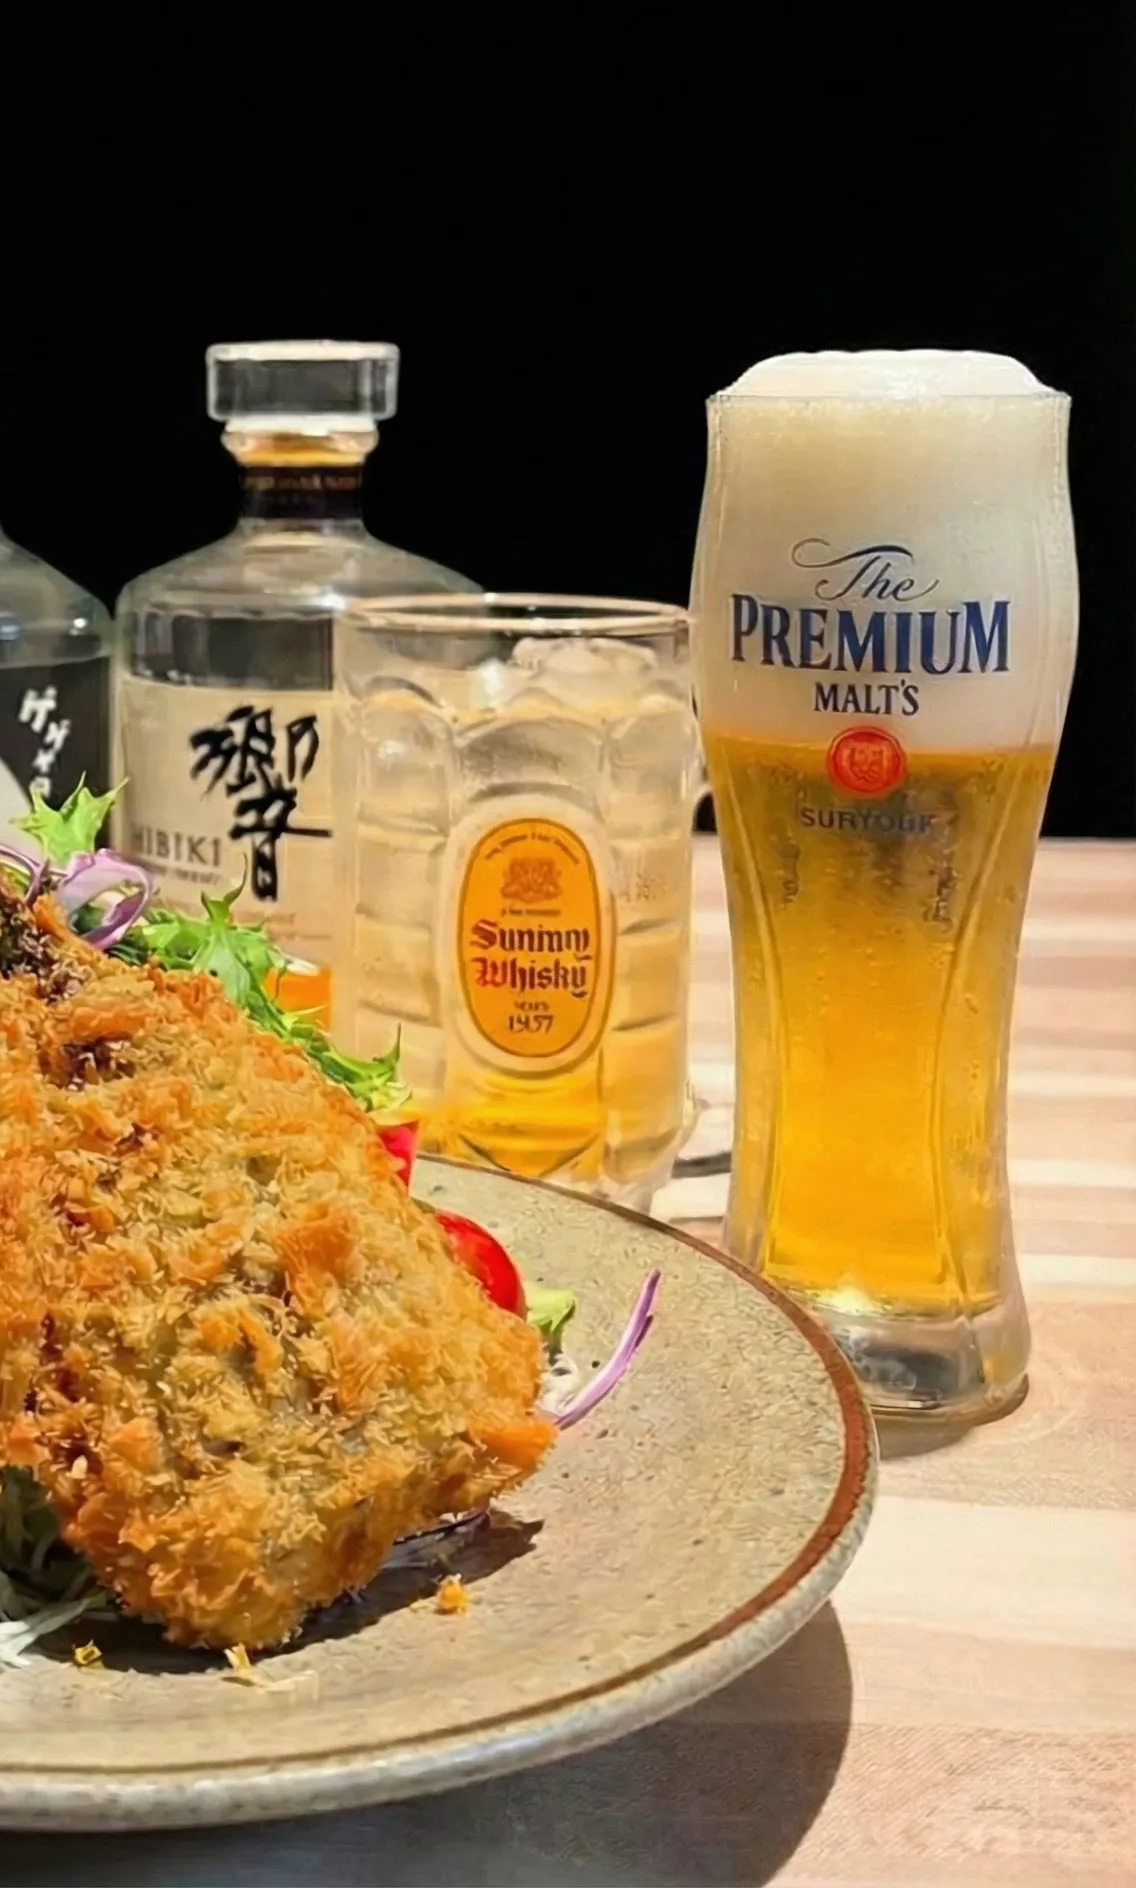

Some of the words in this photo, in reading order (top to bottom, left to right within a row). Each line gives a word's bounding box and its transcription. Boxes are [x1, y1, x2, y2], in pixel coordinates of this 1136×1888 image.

[792, 538, 940, 601] The
[731, 594, 1011, 675] PREMIUM
[814, 679, 920, 716] MALT'S
[471, 957, 589, 999] Whisky
